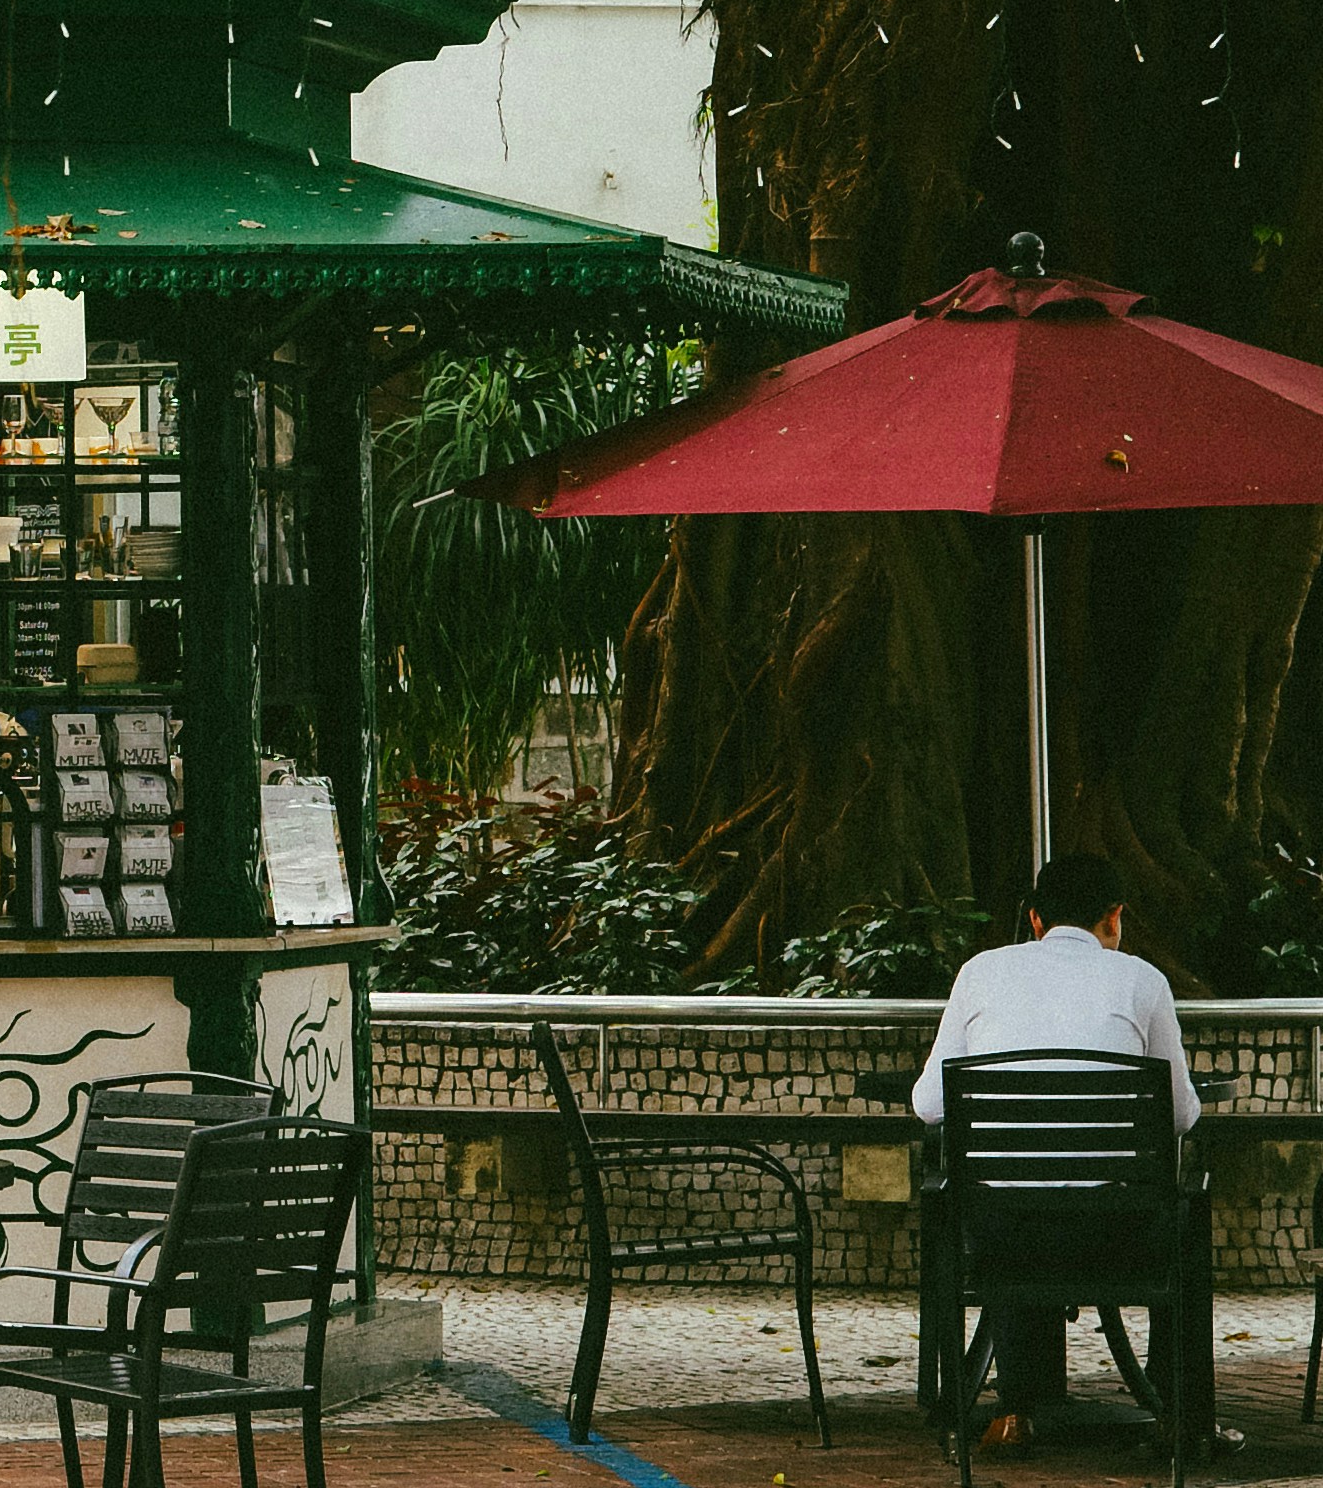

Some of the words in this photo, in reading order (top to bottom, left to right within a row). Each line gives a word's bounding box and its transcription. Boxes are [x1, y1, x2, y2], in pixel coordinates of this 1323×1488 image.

[19, 620, 49, 630] Saturday
[123, 748, 160, 761] MUTE
[59, 755, 95, 766] MUTE
[67, 801, 102, 814] MUTE
[133, 803, 167, 814] MUTE
[133, 859, 167, 870] MUTE
[71, 911, 105, 923] MUTE
[133, 916, 168, 927] MUTE
